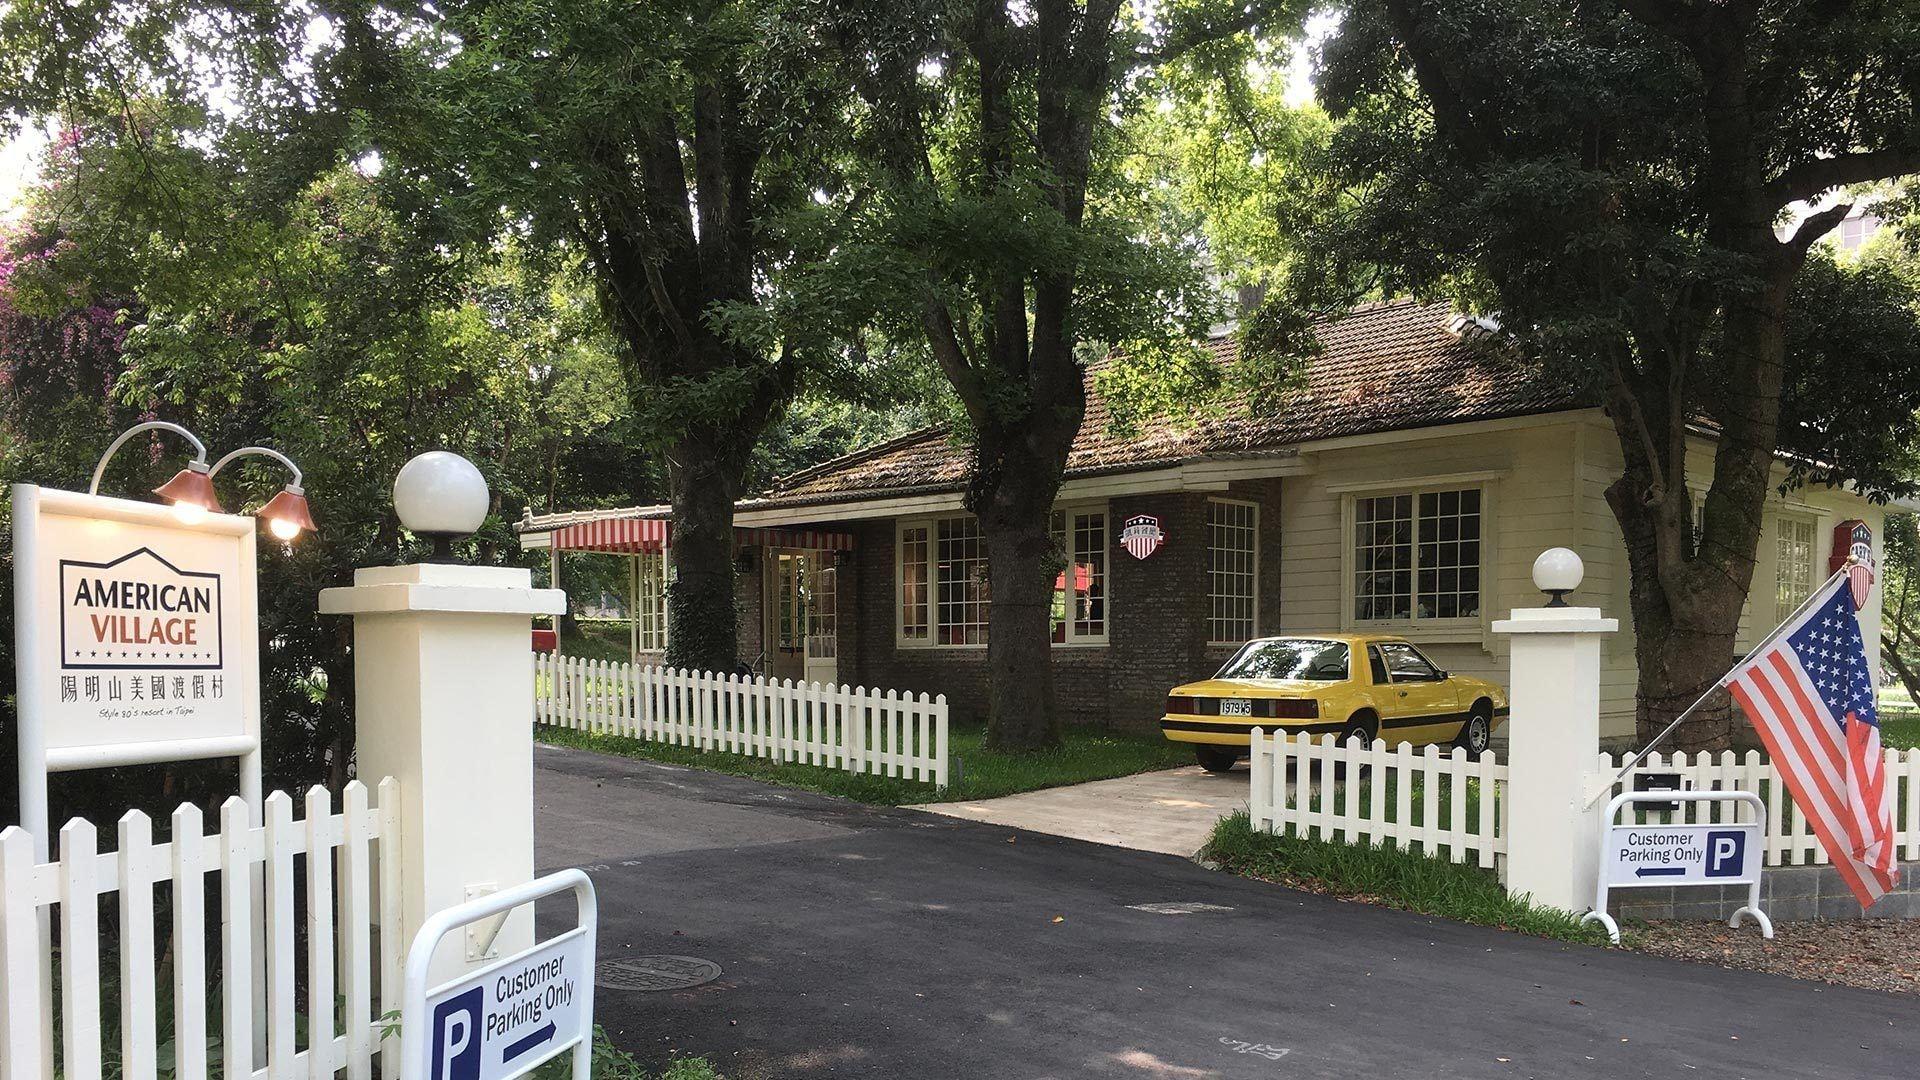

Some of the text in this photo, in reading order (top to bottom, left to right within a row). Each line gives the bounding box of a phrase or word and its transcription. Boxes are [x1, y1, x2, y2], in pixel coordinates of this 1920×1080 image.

[73, 578, 211, 614] AMERICAN
[90, 614, 197, 645] VILLAGE
[61, 675, 223, 702] 陽明山美國渡假村
[98, 708, 119, 720] Style
[121, 706, 139, 718] 80's
[141, 708, 164, 716] resort
[174, 705, 195, 717] Taipei
[1628, 832, 1693, 846] Customer
[1713, 837, 1737, 871] P
[1620, 847, 1703, 864] Parking Only
[496, 954, 565, 1003] Customer
[486, 978, 574, 1042] Parking Only
[442, 1008, 472, 1080] P
